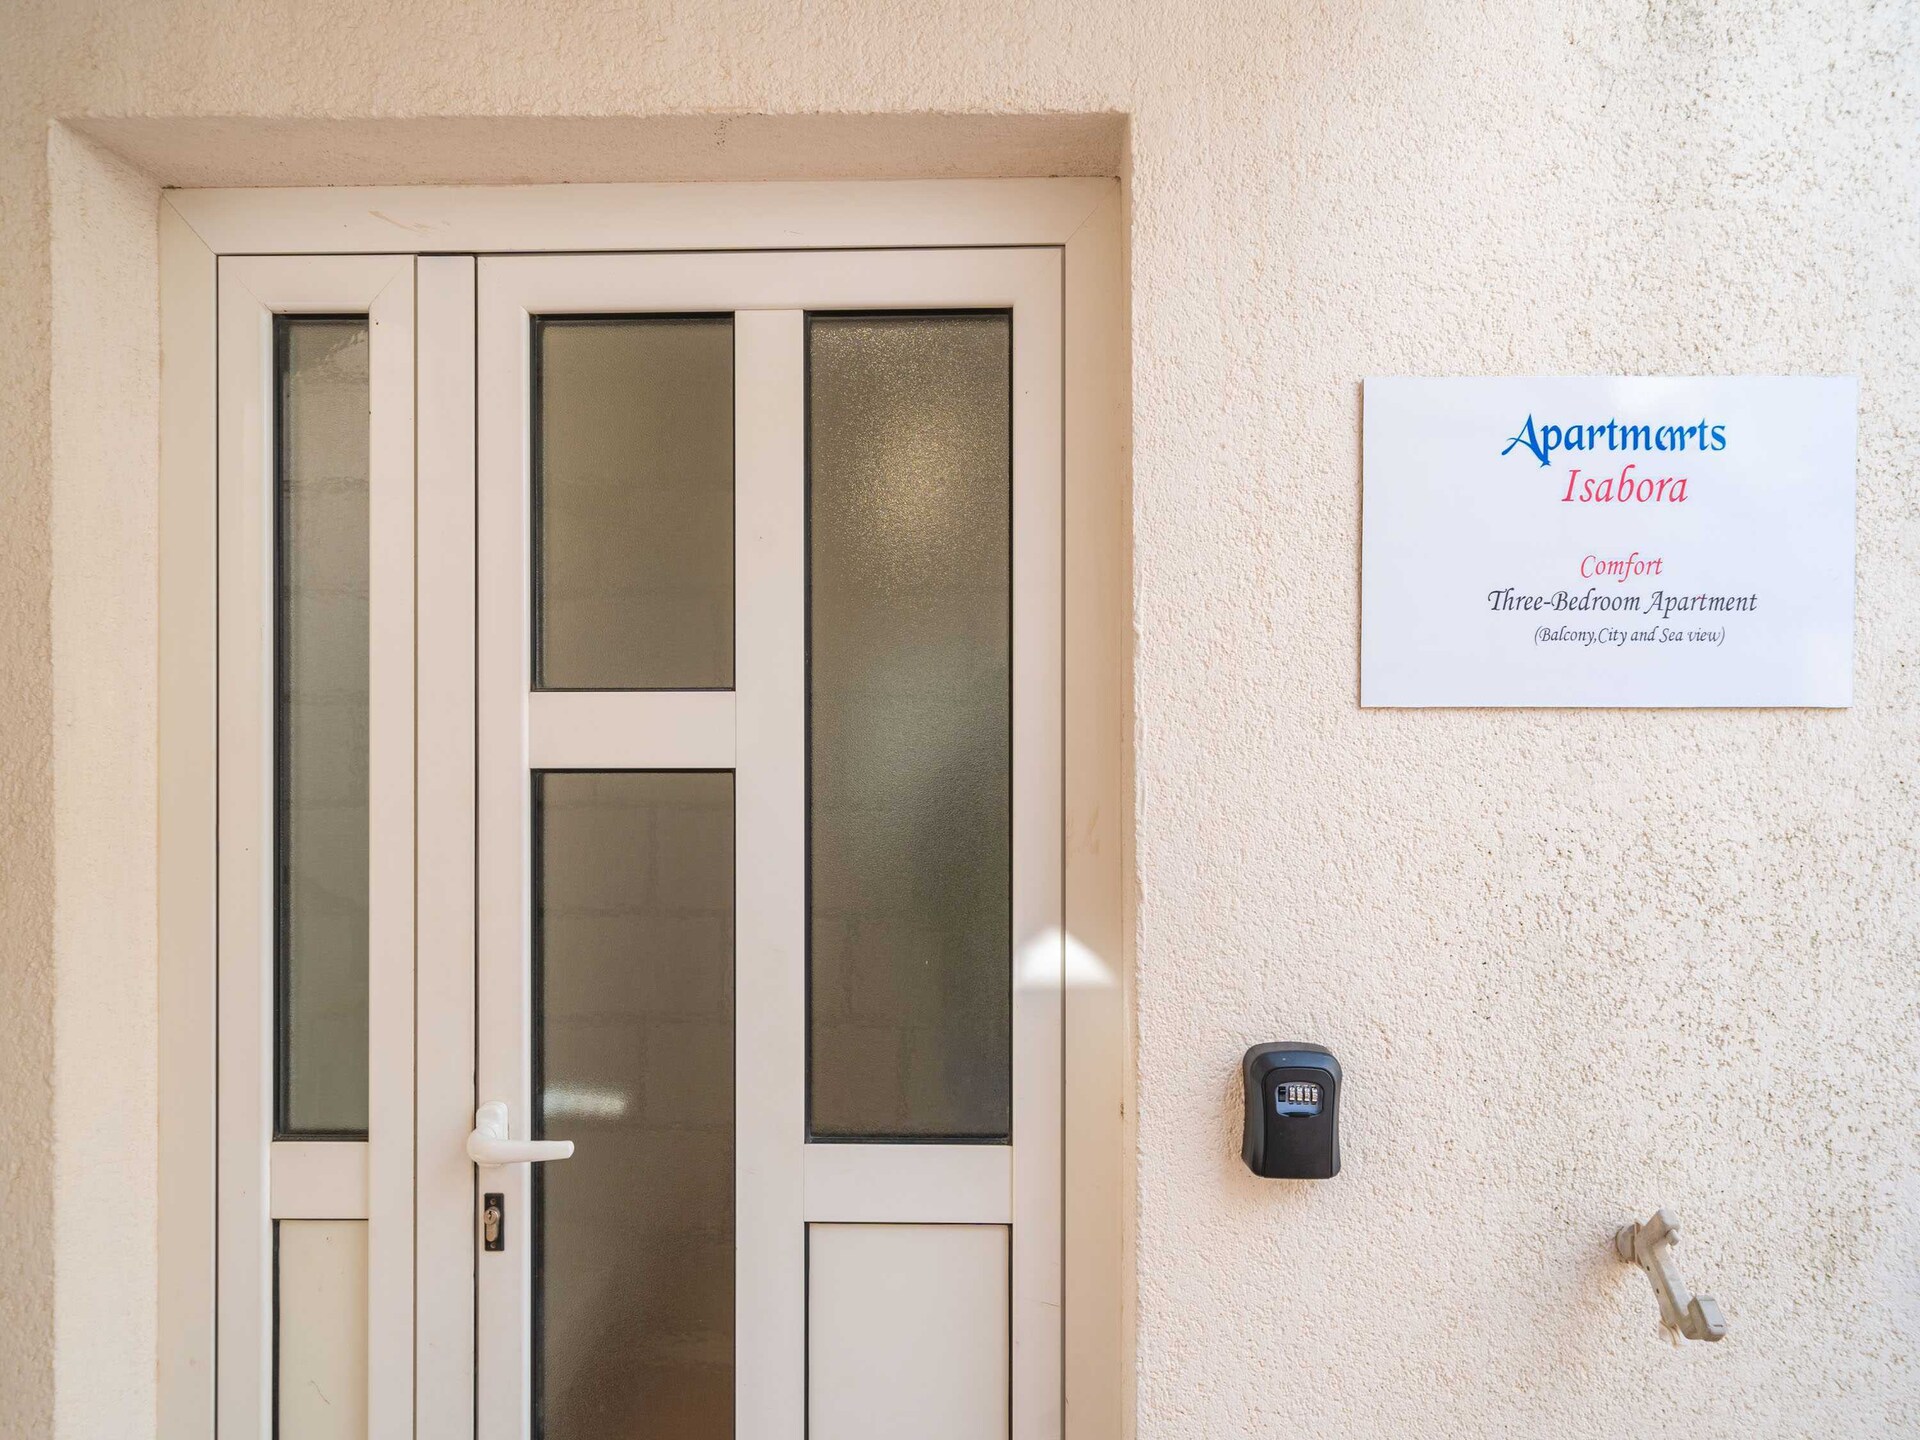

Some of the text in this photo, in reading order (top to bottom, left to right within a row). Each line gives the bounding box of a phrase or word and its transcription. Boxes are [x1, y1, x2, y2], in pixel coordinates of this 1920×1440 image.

[1501, 413, 1727, 468] Apartments
[1561, 464, 1689, 503] Isabora
[1580, 552, 1663, 583] Comfort
[1487, 587, 1758, 619] Three-Bedroom Apartment
[1630, 626, 1656, 643] and
[1658, 627, 1684, 643] Sea
[1686, 626, 1726, 647] view)
